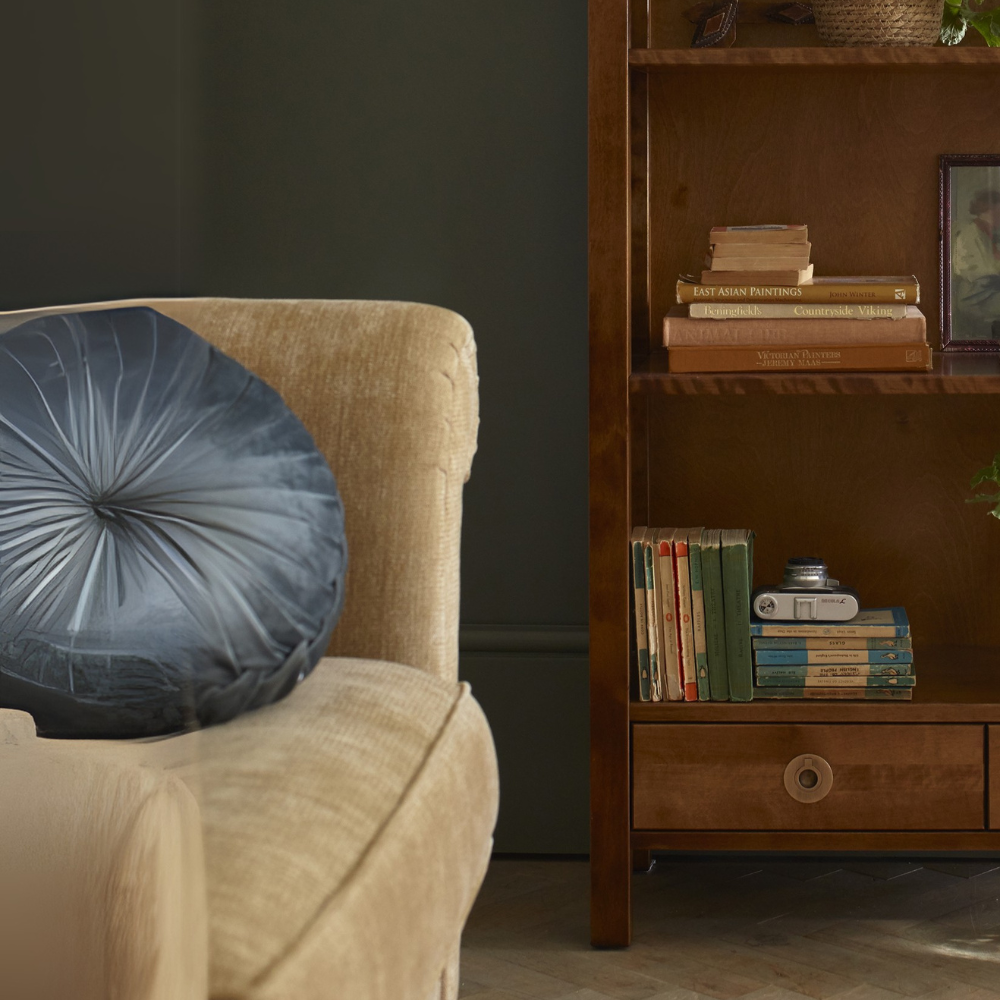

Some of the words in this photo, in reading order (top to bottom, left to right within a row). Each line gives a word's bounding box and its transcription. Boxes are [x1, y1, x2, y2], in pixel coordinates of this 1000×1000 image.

[693, 286, 717, 297] EAST
[717, 286, 747, 297] ASIAN
[749, 286, 803, 297] PAINTINGS
[829, 291, 848, 299] JOHN
[849, 291, 876, 299] WINTER
[703, 305, 763, 318] Beningfield's
[793, 305, 854, 318] Countryside
[857, 305, 893, 318] Viking
[757, 350, 800, 360] VICTORIAN
[802, 349, 841, 359] PAINTERS
[798, 359, 821, 367] MAAS
